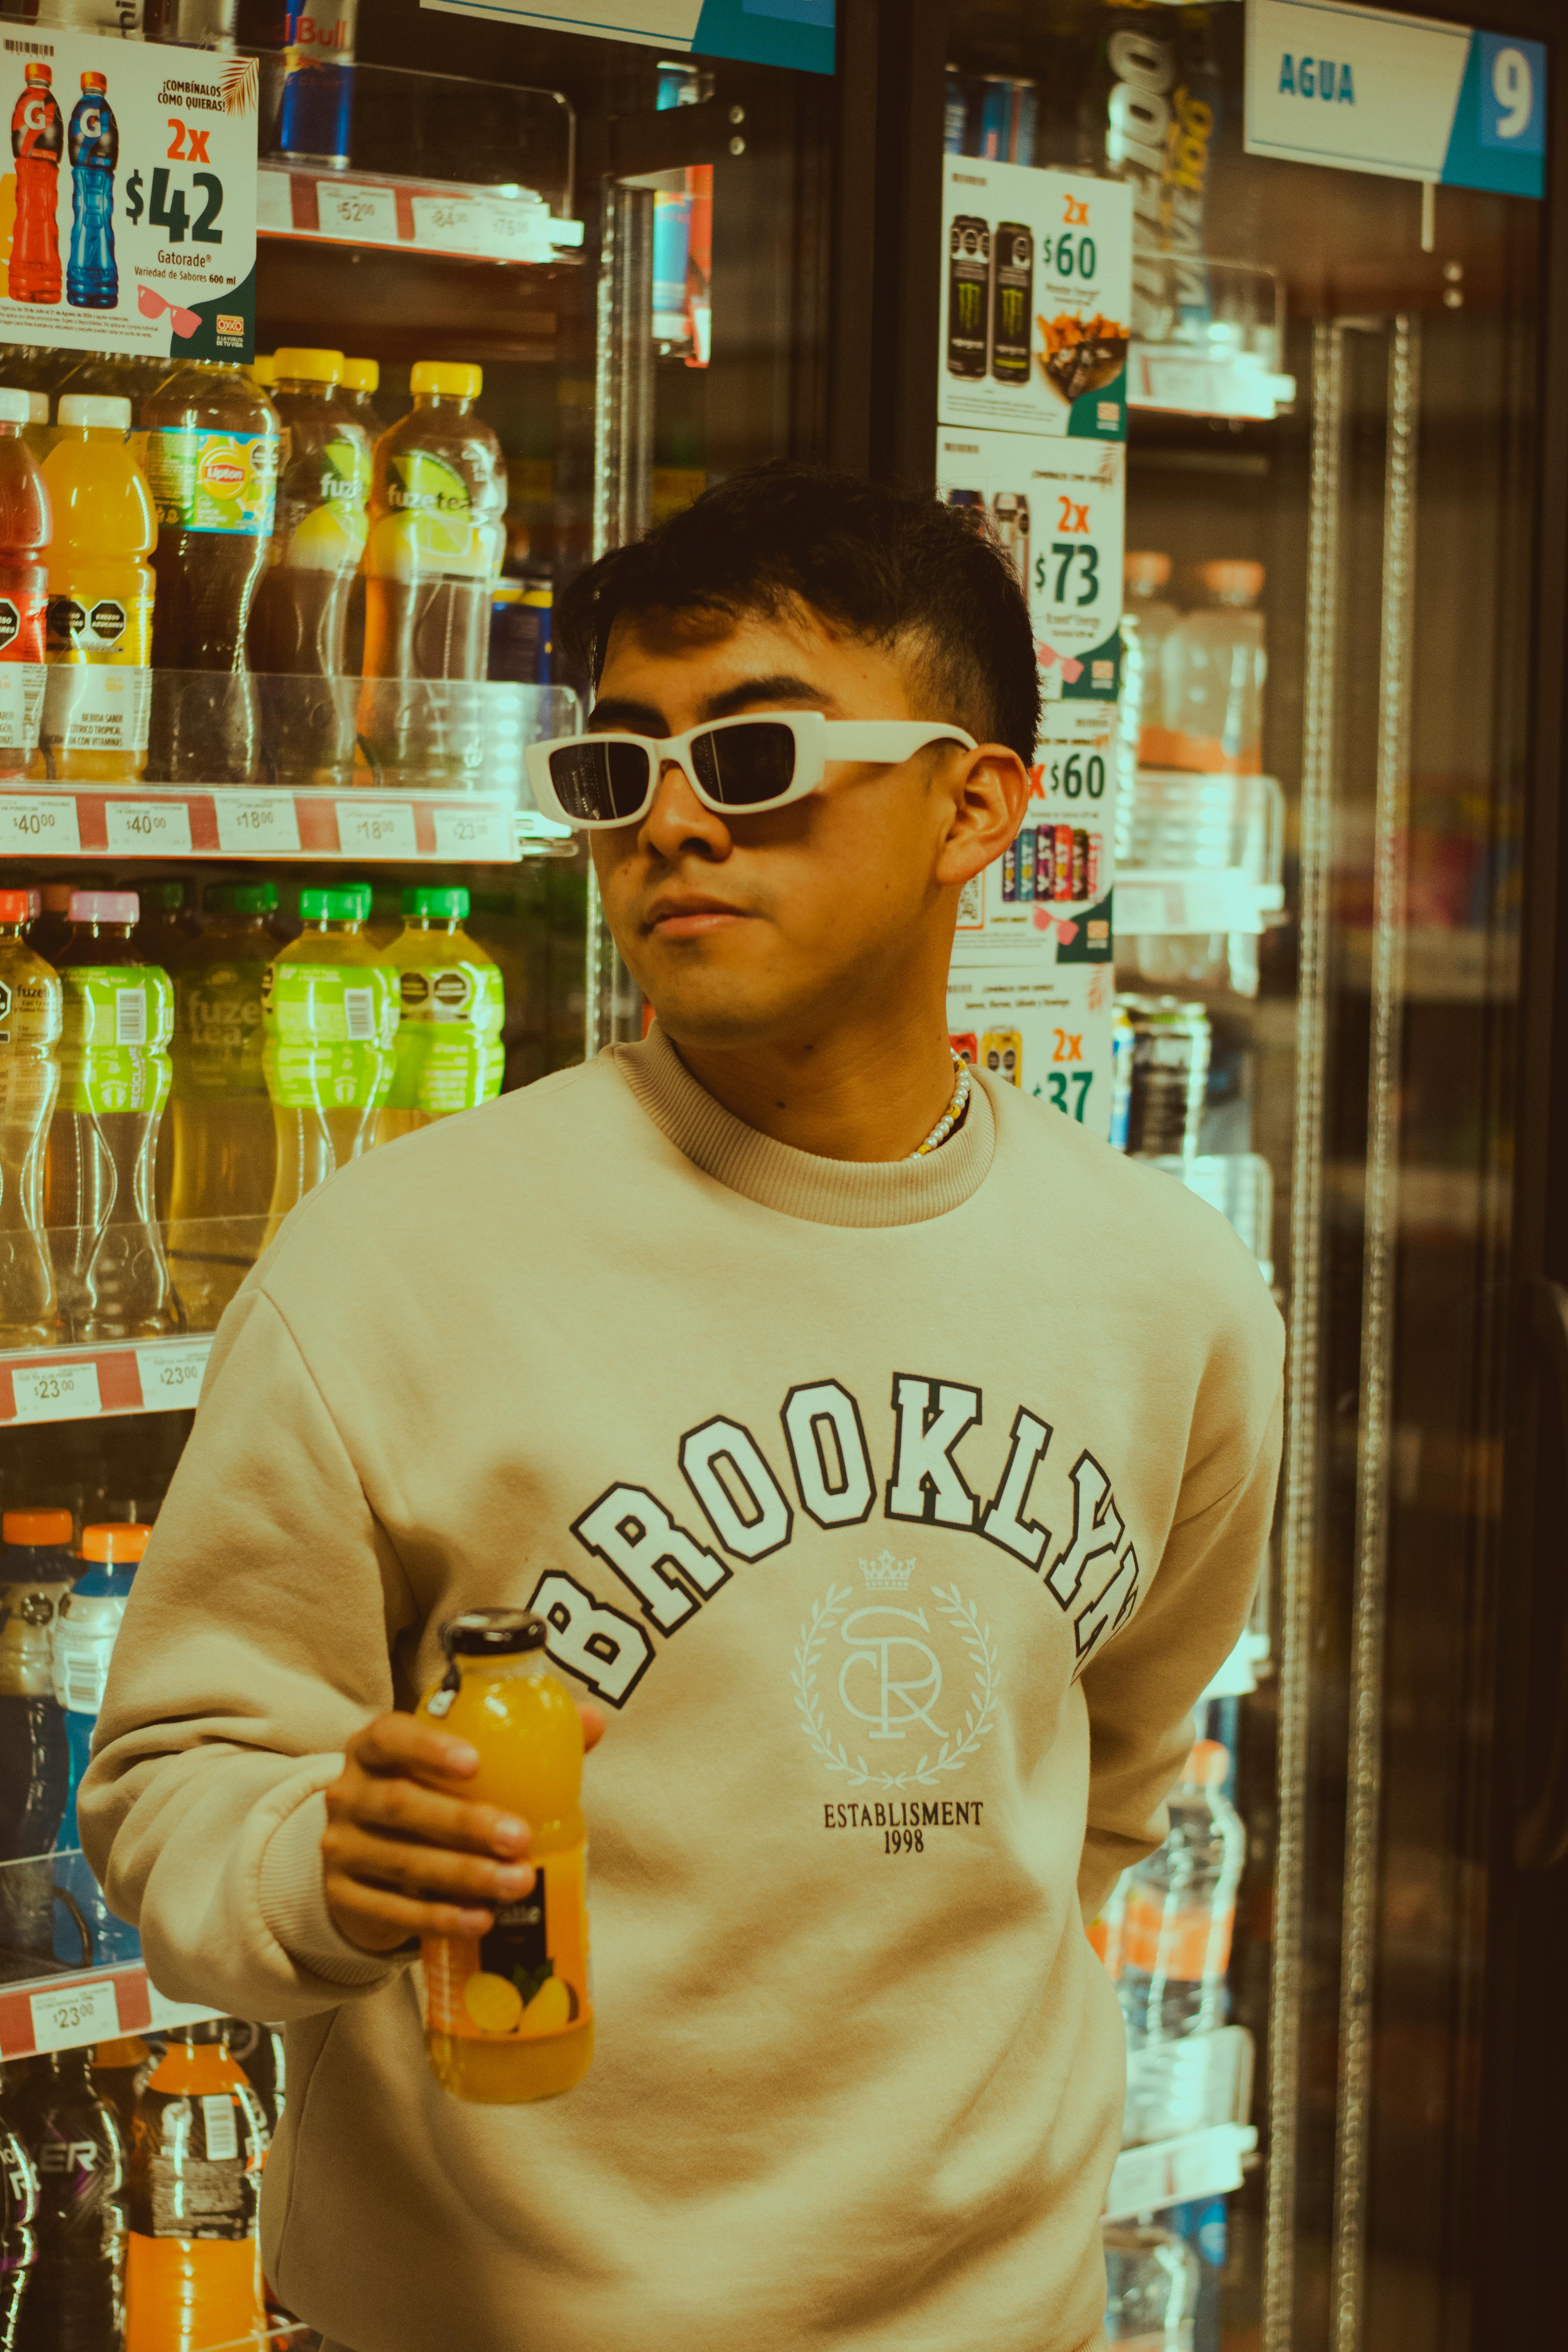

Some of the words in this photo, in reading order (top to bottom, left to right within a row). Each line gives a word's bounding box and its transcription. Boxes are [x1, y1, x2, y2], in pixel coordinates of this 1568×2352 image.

[163, 80, 221, 98] ¡COMBÍNALOS
[1278, 53, 1356, 106] AGUA
[1492, 47, 1533, 139] 9
[158, 92, 183, 107] COMO
[185, 96, 226, 113] QUIERAS!
[167, 119, 211, 164] 2x
[134, 266, 166, 278] Variedad
[168, 270, 177, 279] de
[180, 271, 207, 283] Sabores
[209, 274, 224, 285] 600
[226, 276, 236, 285] ml
[218, 319, 243, 332] OXXO
[207, 467, 243, 480] Lipton
[1057, 495, 1089, 534] 2x
[1034, 543, 1098, 607] $73
[1053, 1028, 1083, 1063] 2x
[524, 1371, 1140, 1710] BROOKLYN
[824, 1801, 984, 1828] ESTABLISMENT
[884, 1829, 924, 1854] 1998
